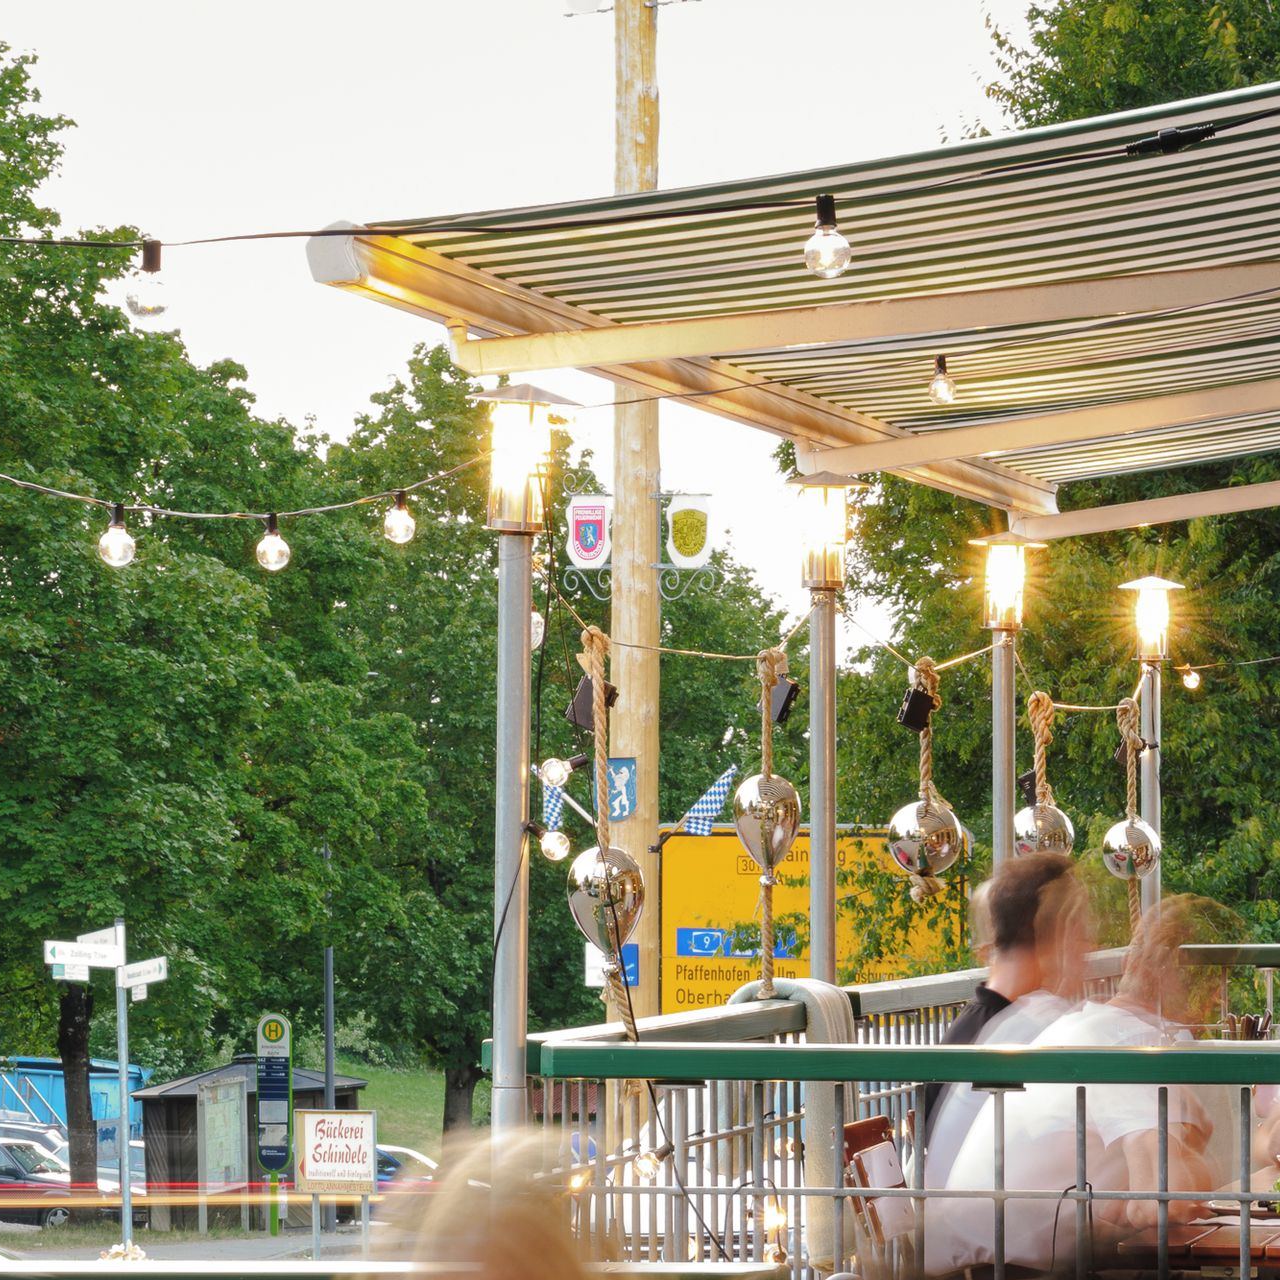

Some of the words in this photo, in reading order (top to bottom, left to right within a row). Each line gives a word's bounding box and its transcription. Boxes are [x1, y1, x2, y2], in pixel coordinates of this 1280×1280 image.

[703, 936, 711, 949] 9
[676, 964, 751, 981] Pfaffenhofen
[675, 988, 732, 1005] Oberha
[312, 1143, 368, 1164] Schindele
